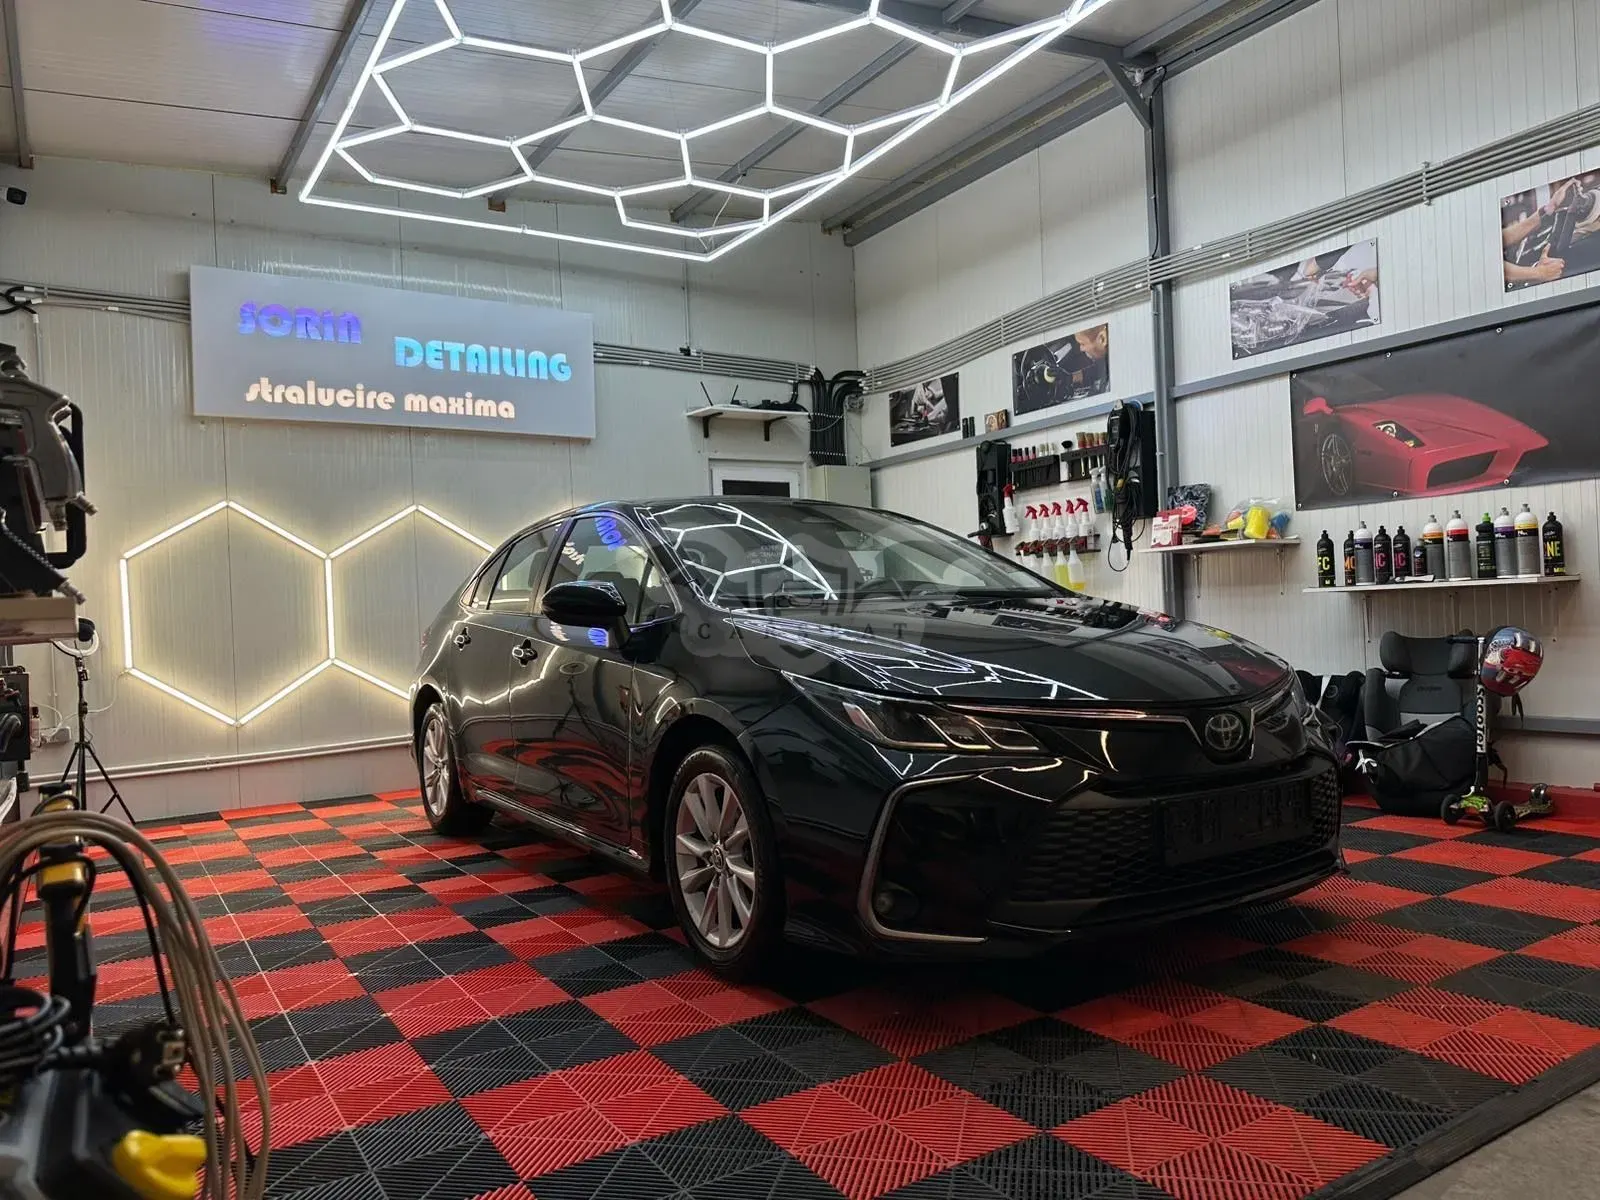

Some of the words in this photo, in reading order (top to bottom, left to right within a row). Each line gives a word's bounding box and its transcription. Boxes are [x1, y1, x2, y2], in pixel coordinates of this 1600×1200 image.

[394, 336, 573, 383] DETAILING
[245, 377, 396, 411] stralucire
[404, 391, 516, 419] maxima
